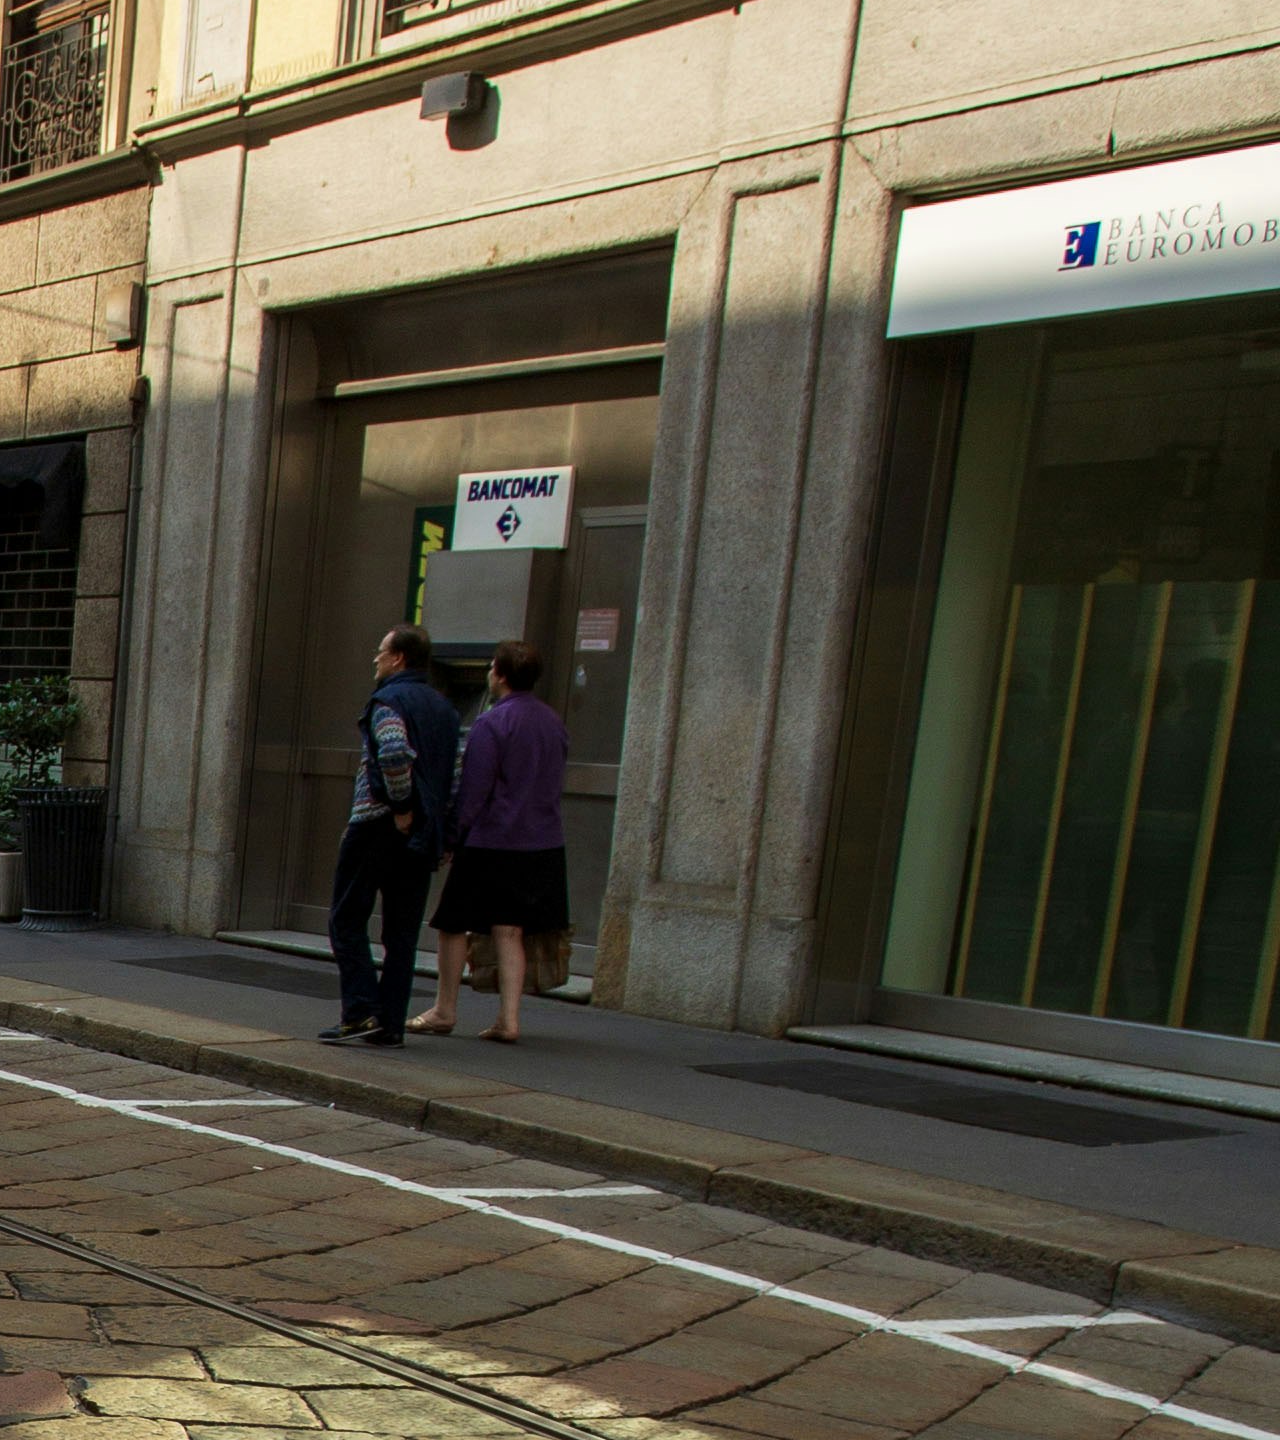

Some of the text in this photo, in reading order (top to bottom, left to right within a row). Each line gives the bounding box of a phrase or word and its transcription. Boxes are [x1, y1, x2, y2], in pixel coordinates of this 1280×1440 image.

[1109, 202, 1224, 241] BANCA
[1104, 219, 1280, 266] EUROMOB
[467, 475, 559, 502] BANCOMAT
